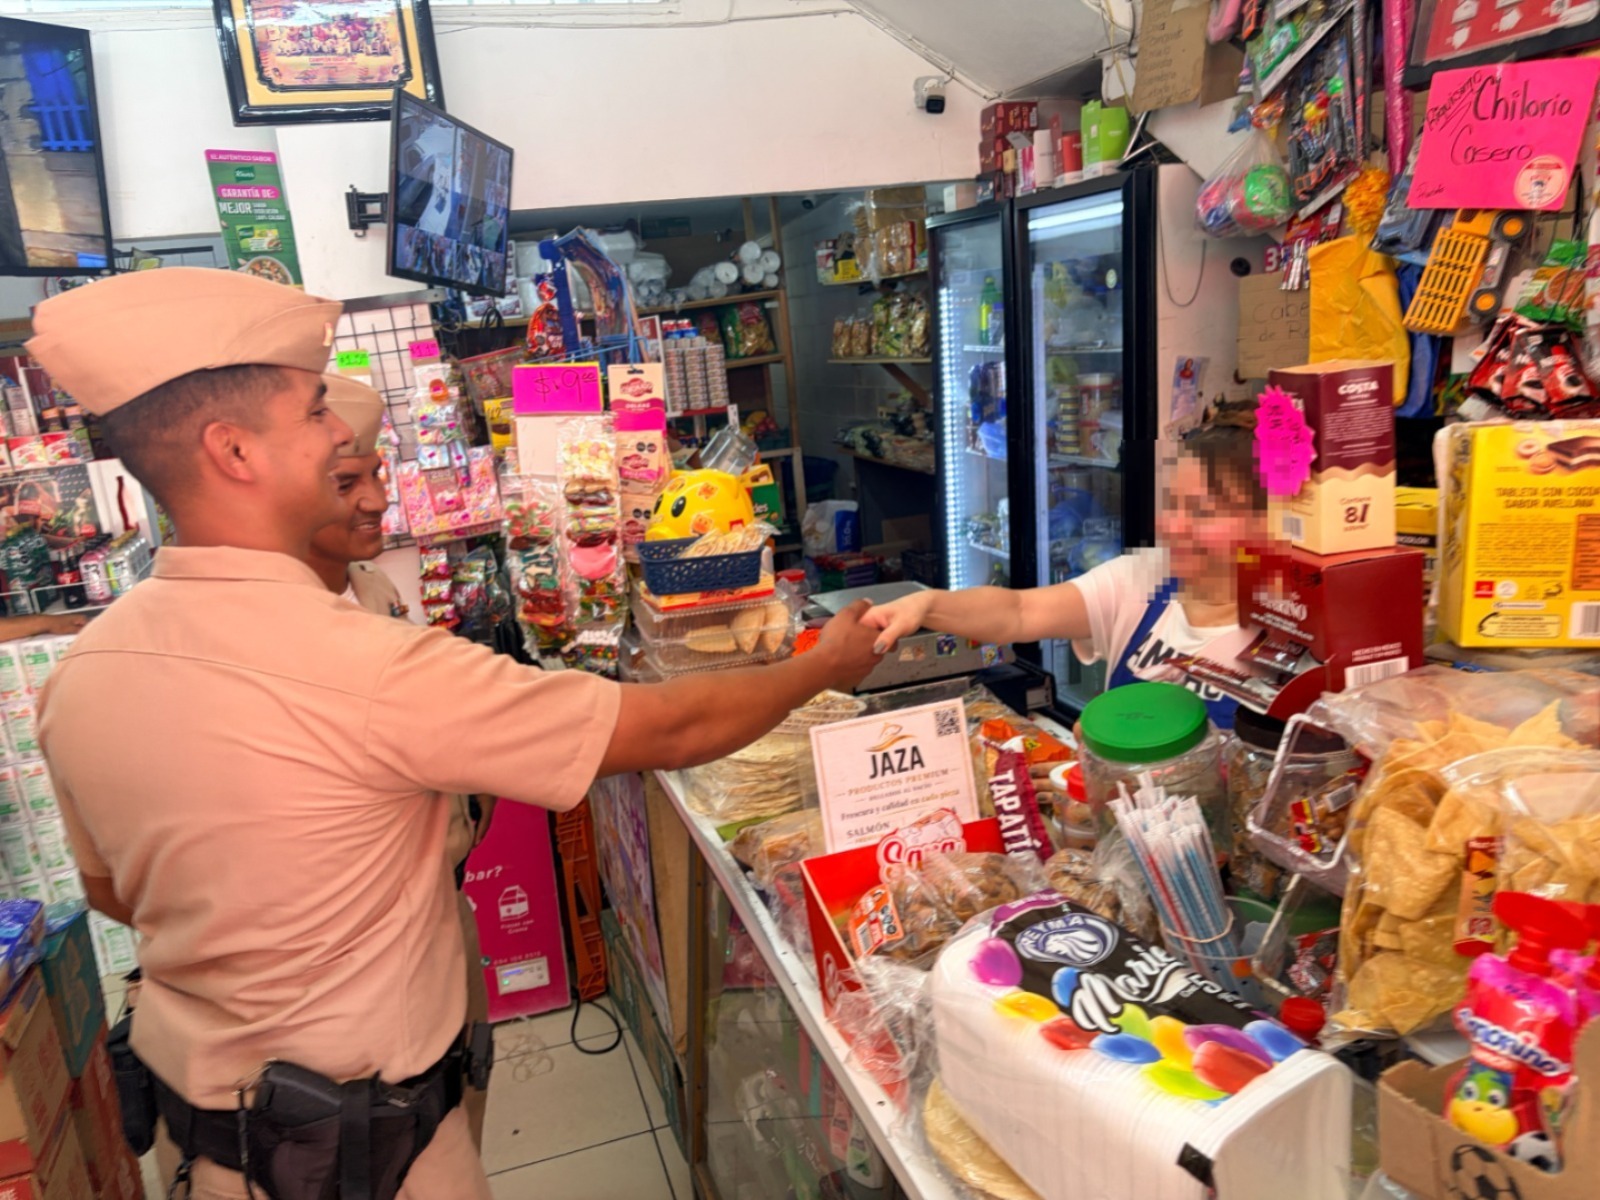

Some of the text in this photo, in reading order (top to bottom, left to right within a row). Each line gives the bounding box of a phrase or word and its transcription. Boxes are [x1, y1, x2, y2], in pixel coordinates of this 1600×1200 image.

[1473, 75, 1572, 121] Chilorio
[1450, 123, 1533, 166] Casero
[218, 201, 253, 214] MEJOR
[221, 187, 260, 198] GARANTÍA
[1337, 380, 1380, 395] COSTA
[869, 745, 925, 780] JAZA
[848, 767, 949, 797] PRODUCTOS PREMIUM
[840, 806, 875, 822] Frescura
[881, 798, 909, 813] calidad
[989, 768, 1042, 858] TAPATÍ
[846, 820, 891, 838] SALMÓN
[1020, 914, 1085, 950] REYMA
